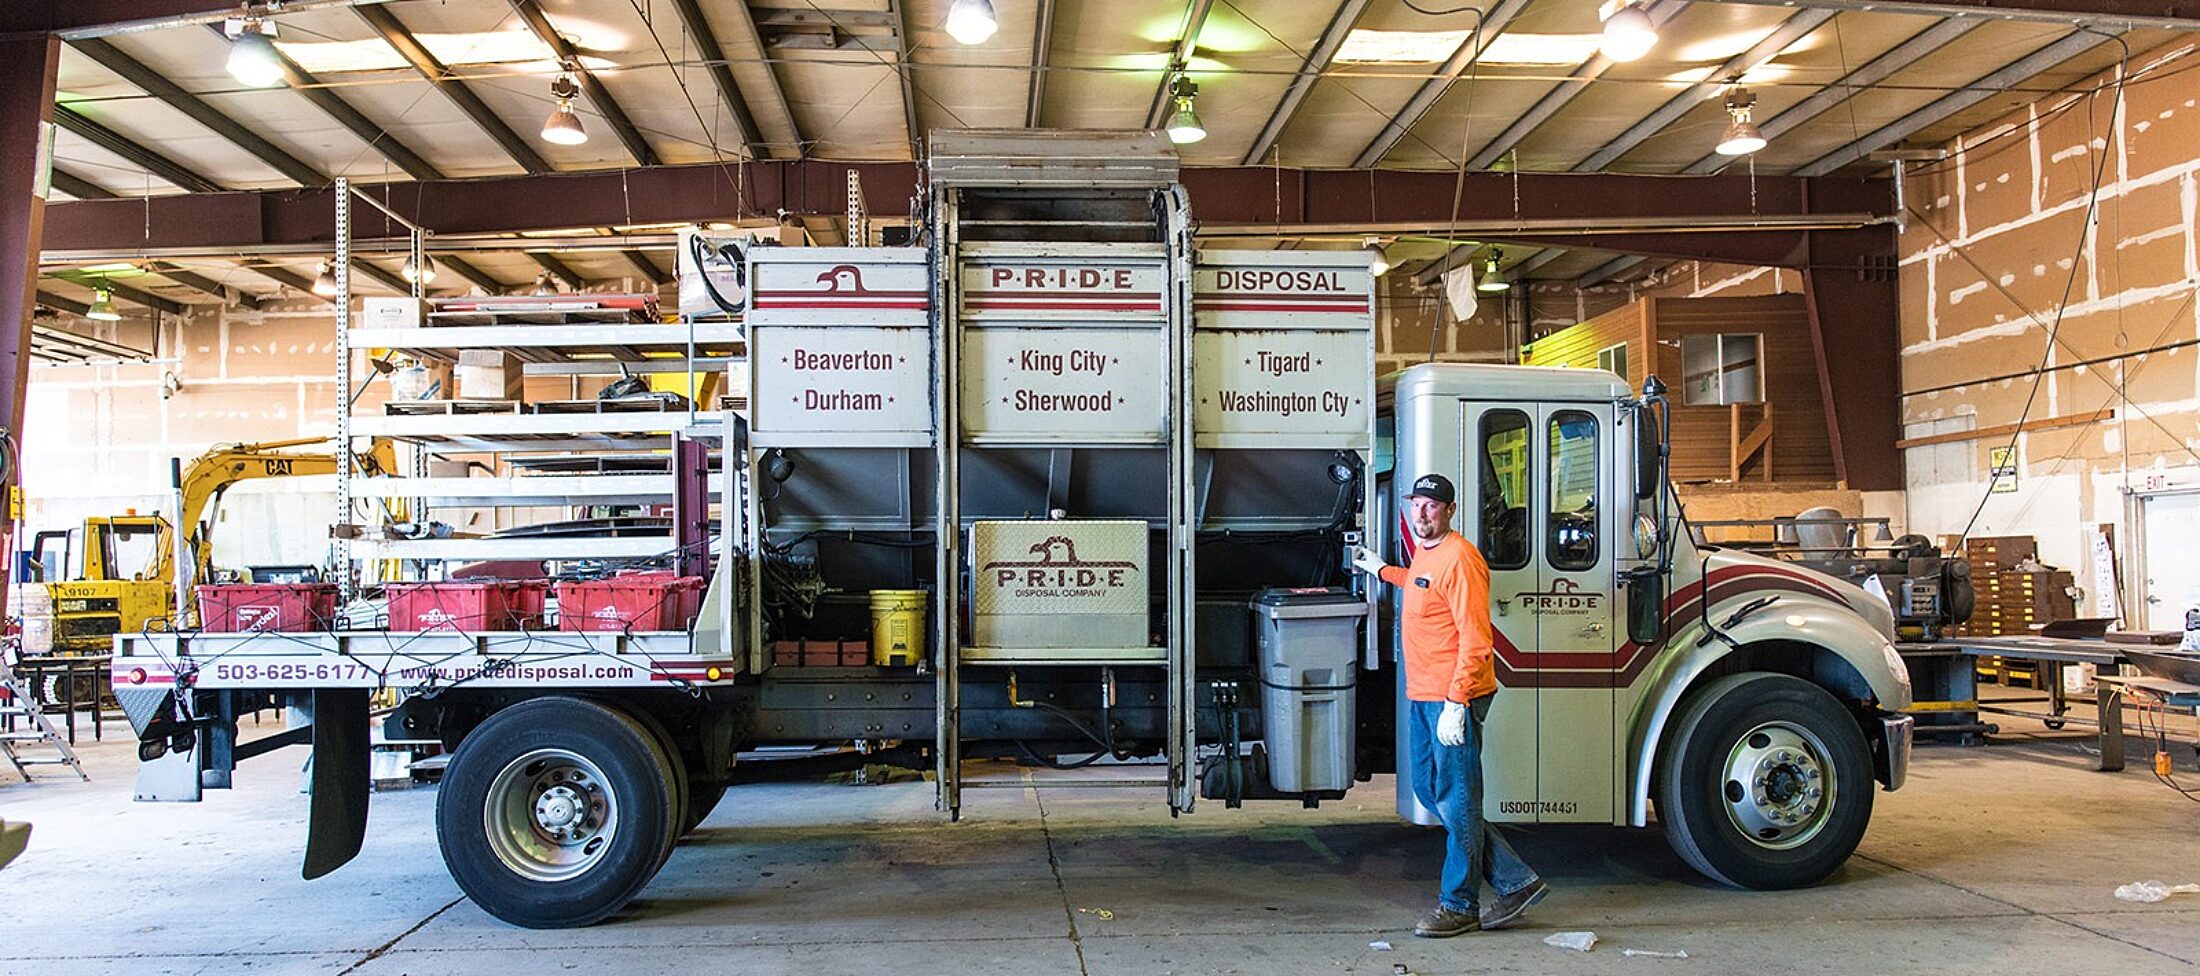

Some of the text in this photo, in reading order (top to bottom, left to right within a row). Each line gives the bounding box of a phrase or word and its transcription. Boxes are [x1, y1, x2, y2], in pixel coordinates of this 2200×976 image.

[1216, 271, 1346, 291] DISPOSAL
[794, 349, 893, 371] Beaverton
[1021, 350, 1107, 376] King City
[1257, 351, 1310, 377] Tigard
[805, 389, 882, 411] Durham
[1015, 389, 1112, 412] Sherwood
[1218, 391, 1349, 417] Washington Cty
[265, 458, 294, 476] CAT
[2147, 475, 2165, 489] EXIT
[1015, 589, 1107, 598] DISPOSAL COMPANY
[217, 664, 371, 680] 503-625-6177
[1500, 802, 1577, 814] USDOT 744451
